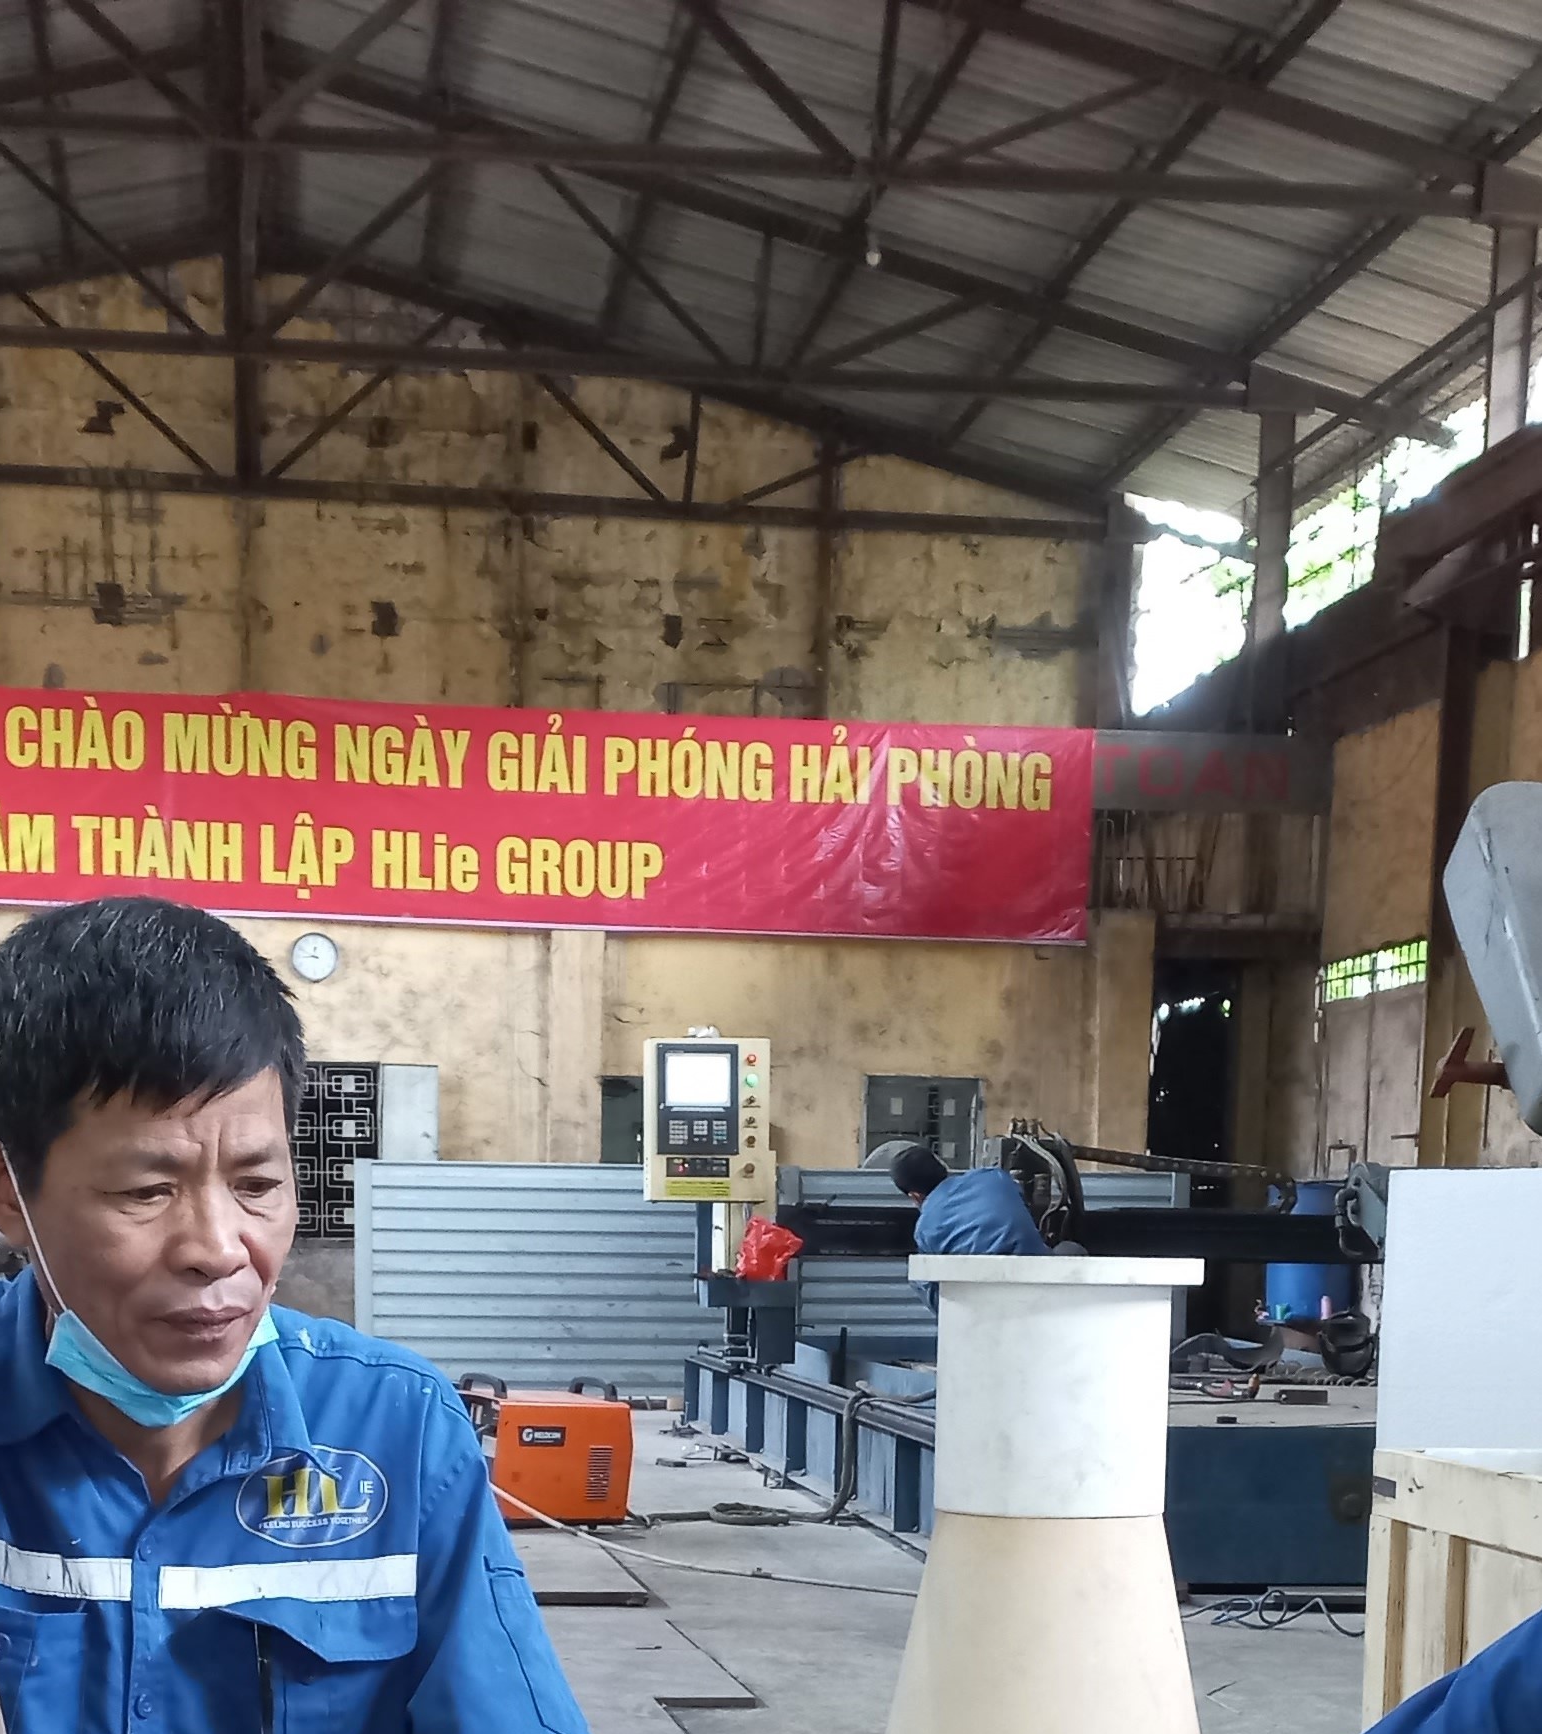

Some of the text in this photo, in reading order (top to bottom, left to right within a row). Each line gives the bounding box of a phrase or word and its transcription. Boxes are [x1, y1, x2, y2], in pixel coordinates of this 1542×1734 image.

[5, 695, 147, 771] CHÀO
[162, 702, 318, 781] MỪNG
[334, 713, 472, 789] NGÀY
[487, 712, 587, 795] GIẢI
[604, 725, 773, 803] PHÓNG
[789, 722, 871, 808] HẢI
[887, 734, 1053, 812] PHÒNG
[71, 804, 244, 884] THÀNH
[259, 812, 356, 901] LẬP
[371, 828, 481, 894] HLie
[495, 835, 664, 900] GROUP
